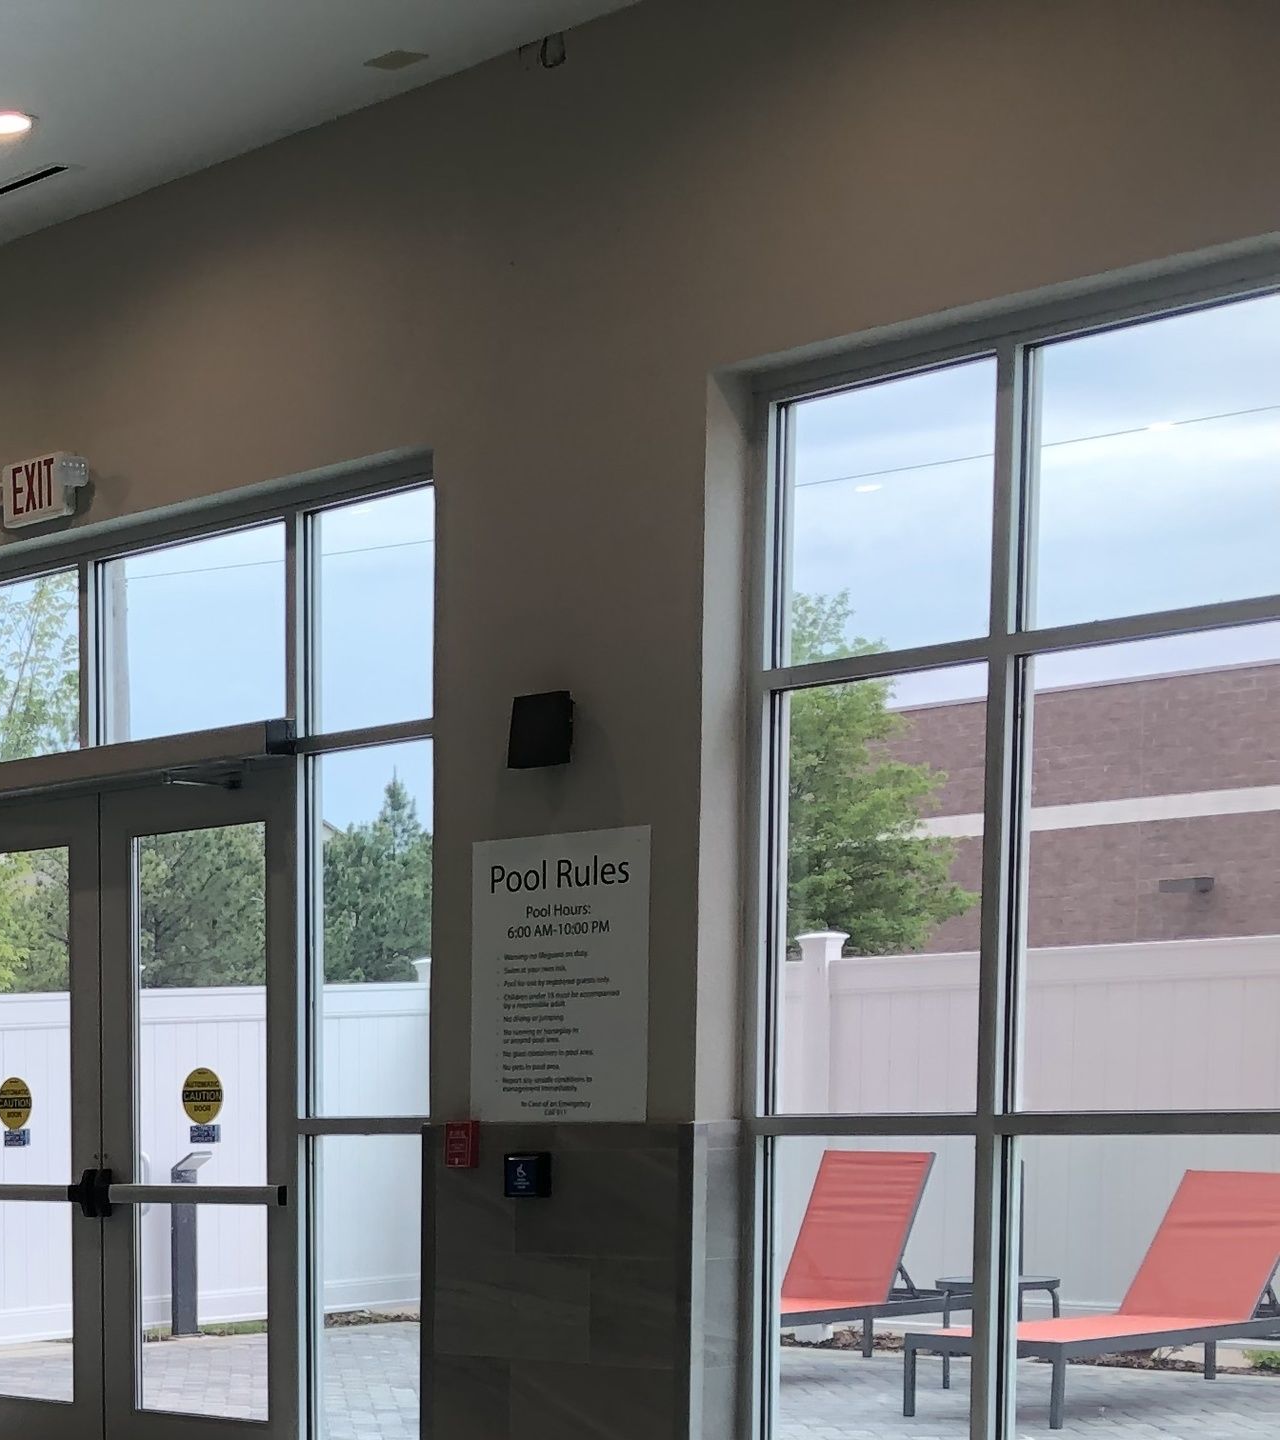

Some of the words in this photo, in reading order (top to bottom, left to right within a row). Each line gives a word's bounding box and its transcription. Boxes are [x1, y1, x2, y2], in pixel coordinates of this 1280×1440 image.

[12, 458, 55, 516] EXIT
[490, 859, 547, 894] Pool
[557, 854, 630, 888] Rules
[526, 904, 551, 919] Pool
[553, 904, 592, 917] Hours:
[507, 925, 532, 939] 6:00
[534, 922, 589, 937] AM-10:00
[591, 920, 610, 934] PM
[183, 1091, 222, 1102] CAUTION
